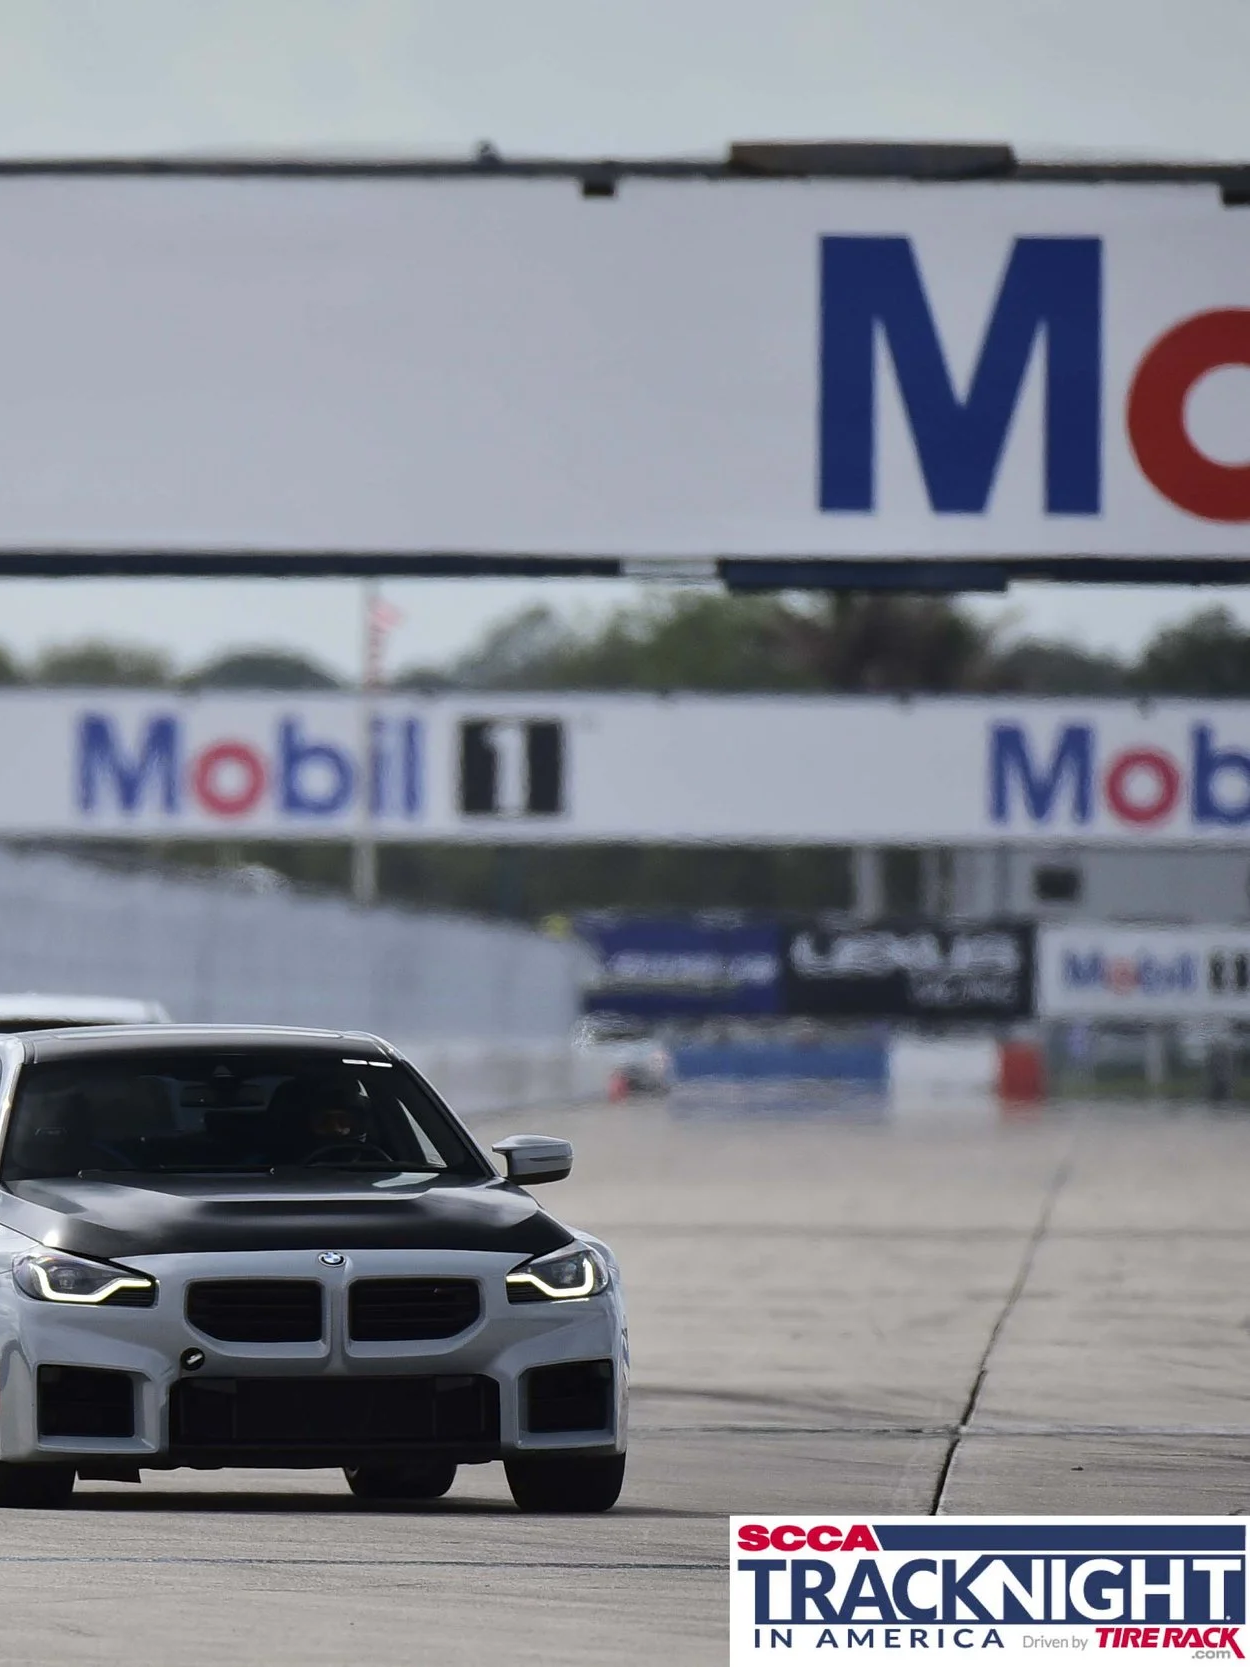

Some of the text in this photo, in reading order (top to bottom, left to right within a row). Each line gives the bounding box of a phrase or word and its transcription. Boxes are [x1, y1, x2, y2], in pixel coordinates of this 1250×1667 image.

[819, 236, 1250, 522] Mo
[76, 712, 530, 818] Mobil 1
[989, 721, 1250, 828] Mob
[1064, 949, 1196, 995] Mobil
